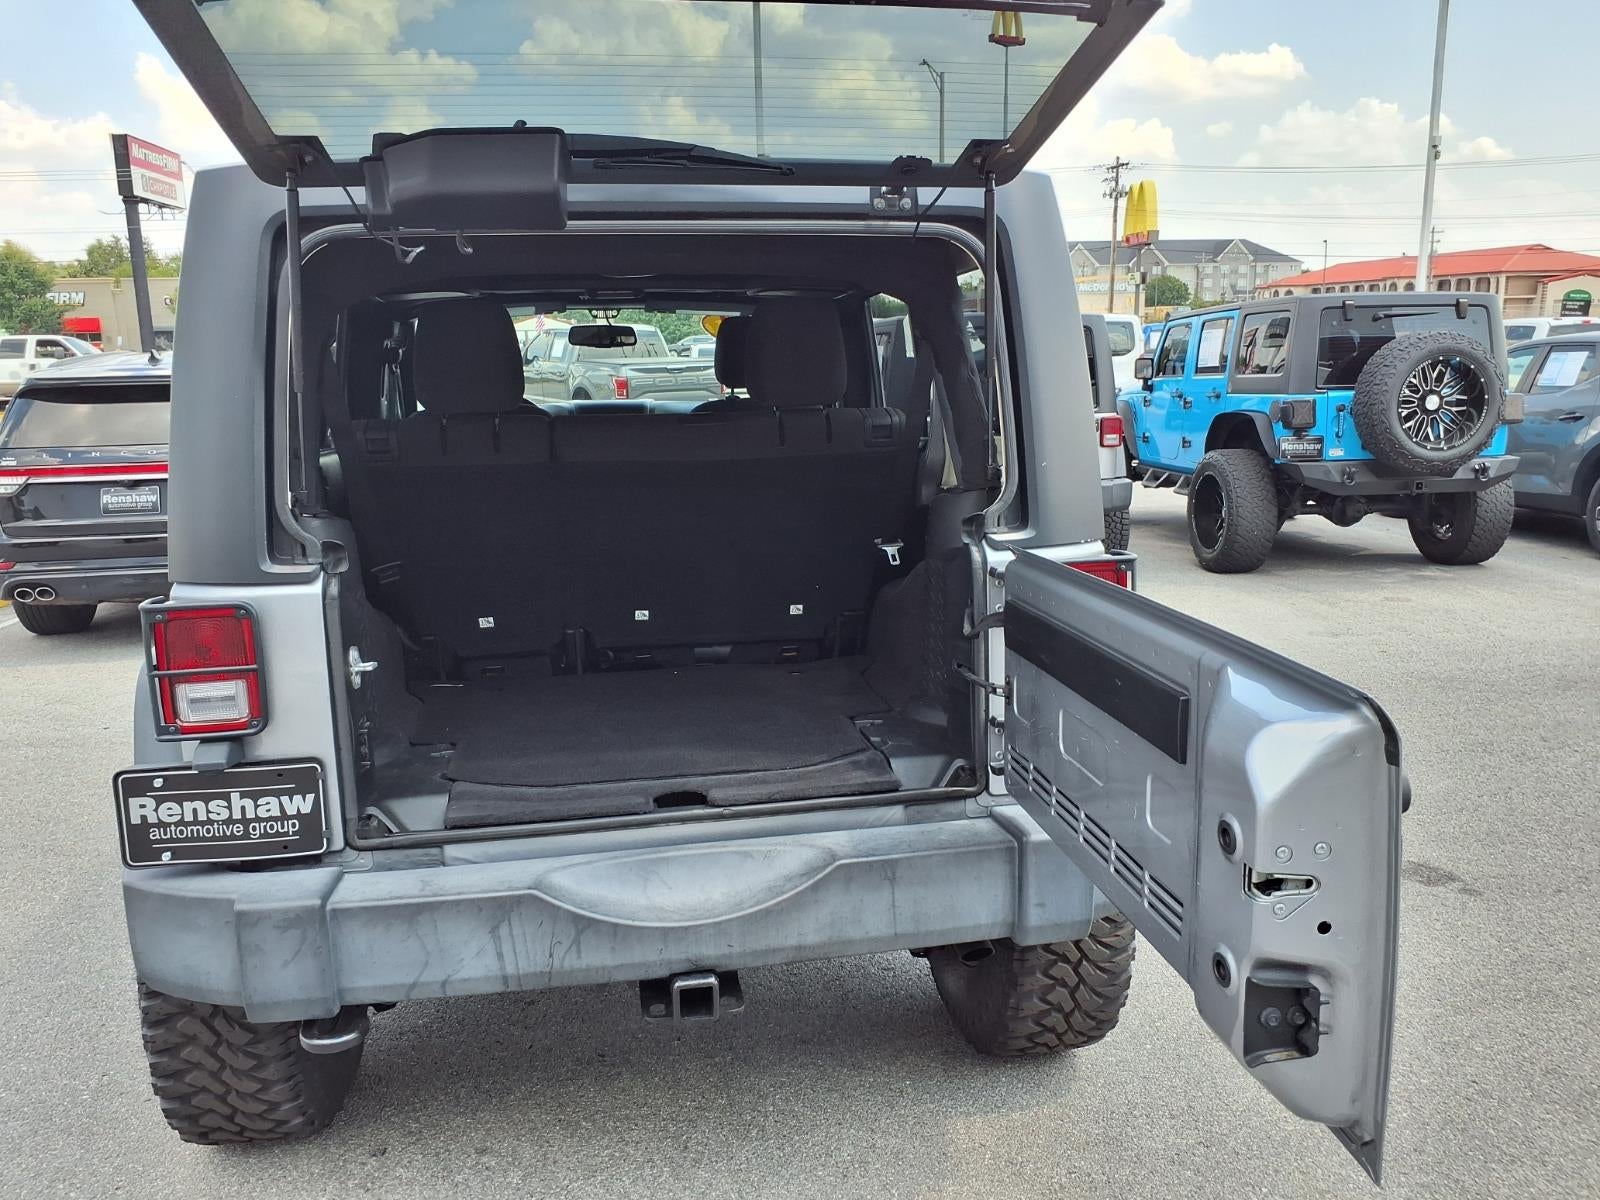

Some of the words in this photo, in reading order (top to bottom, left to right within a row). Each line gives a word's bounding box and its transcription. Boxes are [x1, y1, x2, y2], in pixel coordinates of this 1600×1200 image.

[150, 180, 177, 200] CHIPOTLE
[1282, 442, 1321, 450] Renshaw
[42, 450, 157, 459] LINCO
[103, 493, 157, 504] Renshaw
[137, 501, 153, 510] group
[128, 792, 315, 825] Renshaw
[150, 821, 244, 840] automotive
[249, 818, 300, 839] group
